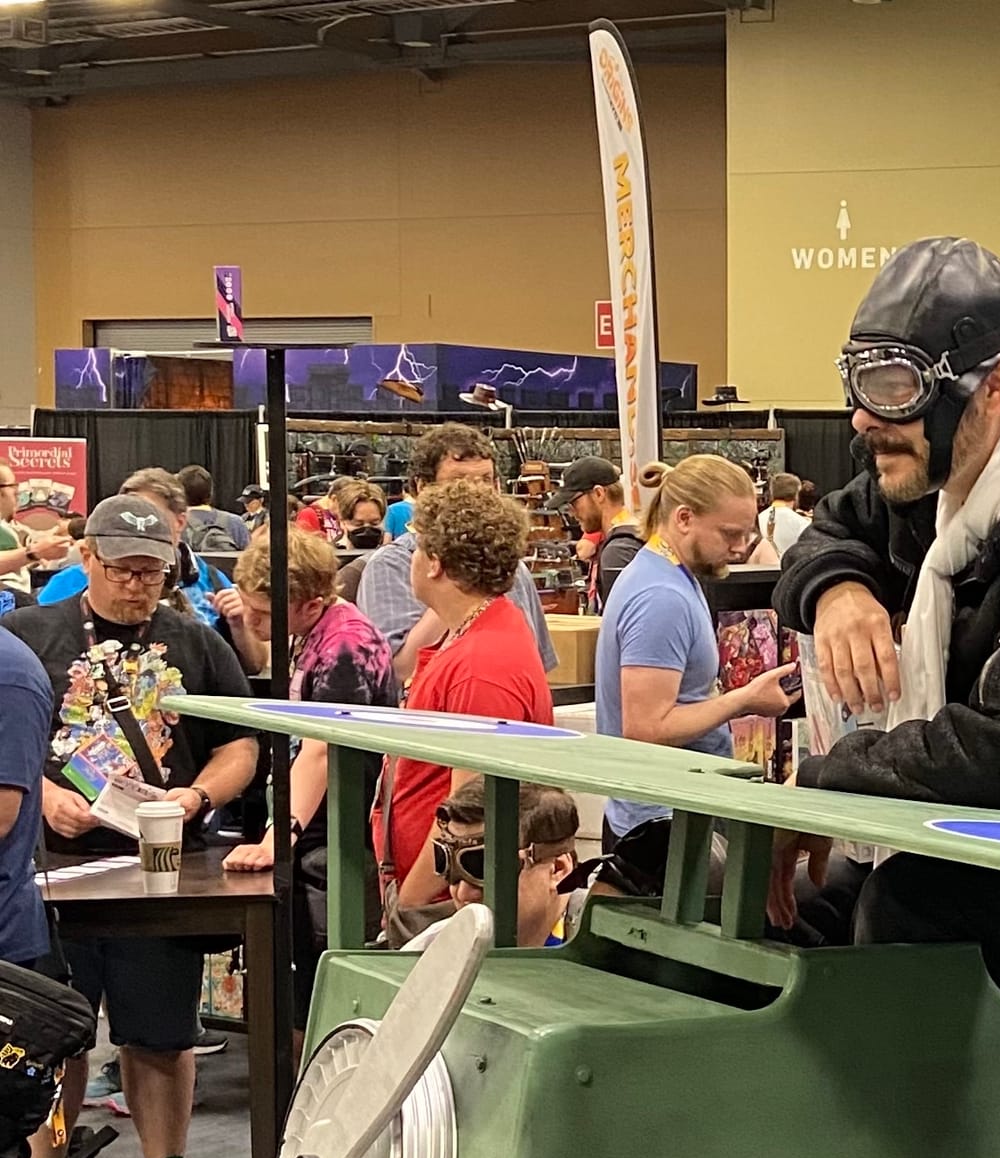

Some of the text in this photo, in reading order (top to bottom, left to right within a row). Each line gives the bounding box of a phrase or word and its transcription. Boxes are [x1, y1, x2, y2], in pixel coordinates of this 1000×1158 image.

[791, 247, 897, 269] WOMEN
[8, 446, 72, 458] Primordial
[9, 457, 71, 469] Secrets
